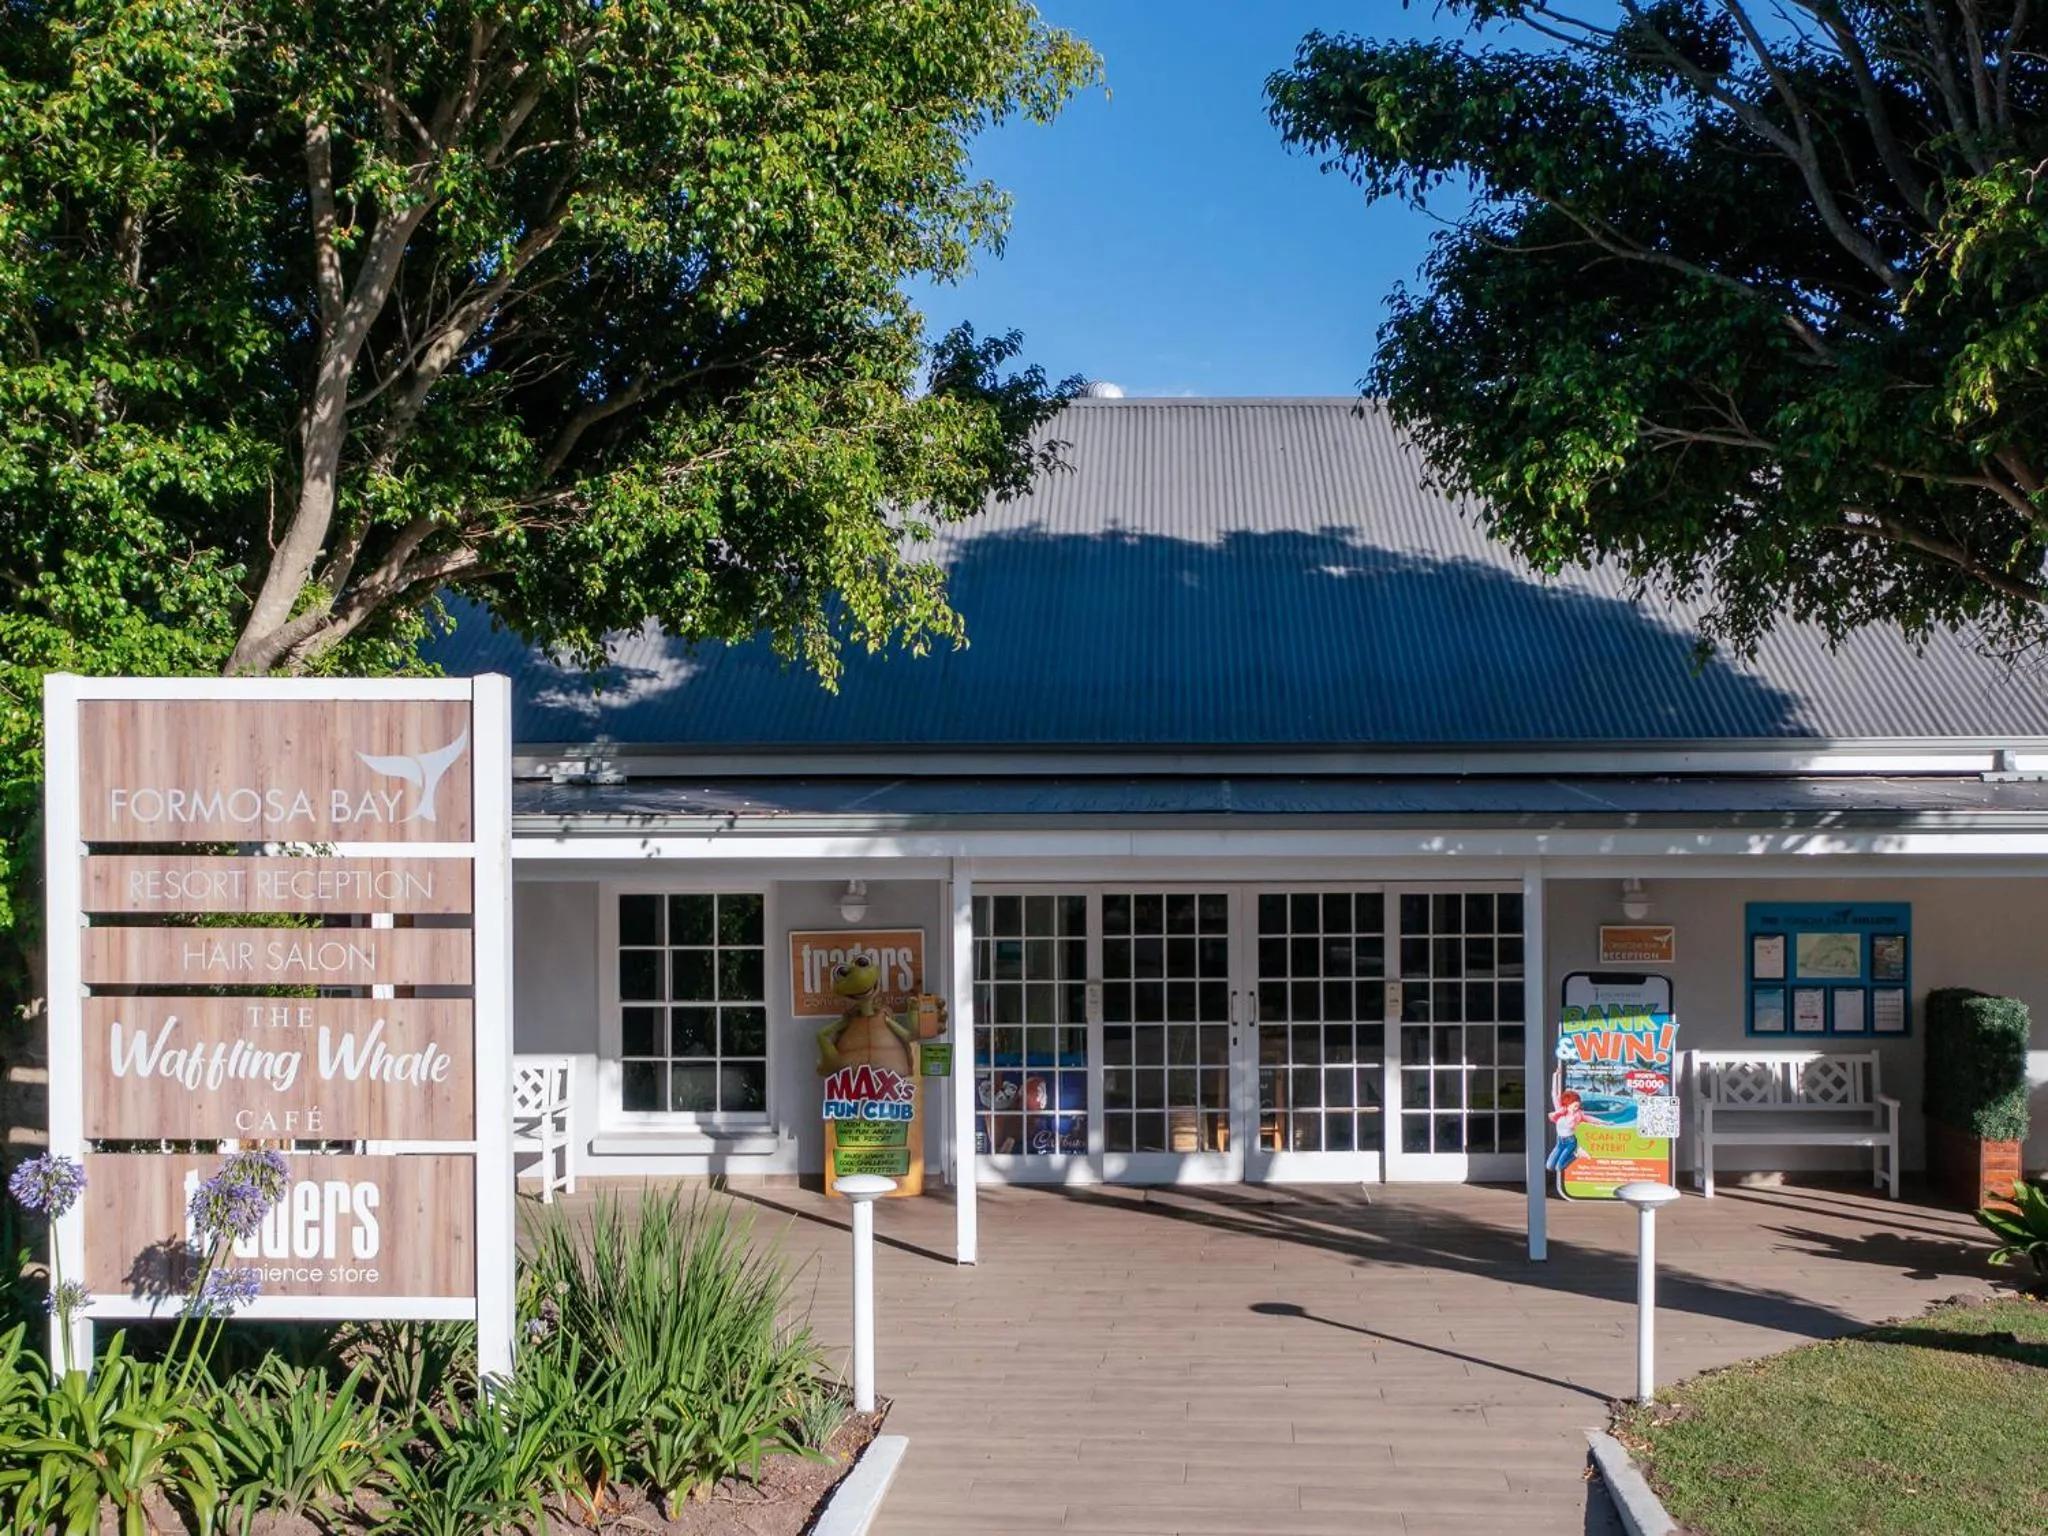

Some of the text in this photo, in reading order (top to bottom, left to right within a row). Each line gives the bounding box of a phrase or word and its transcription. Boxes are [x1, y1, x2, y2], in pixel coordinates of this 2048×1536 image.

[110, 788, 404, 824] FORMOSA BAY
[130, 870, 433, 900] RESORT RECEPTION
[184, 941, 376, 973] HAIR SALON
[802, 943, 914, 993] trrs
[247, 1006, 313, 1028] THE
[1562, 1003, 1659, 1032] BANK
[110, 1015, 452, 1092] Waffling Whale
[1572, 1024, 1676, 1065] WIN!
[235, 1104, 324, 1133] CAFÉ
[824, 1101, 915, 1121] FUN CLUB
[1617, 1132, 1632, 1142] TO
[183, 1167, 379, 1260] tders
[329, 1264, 380, 1283] store
